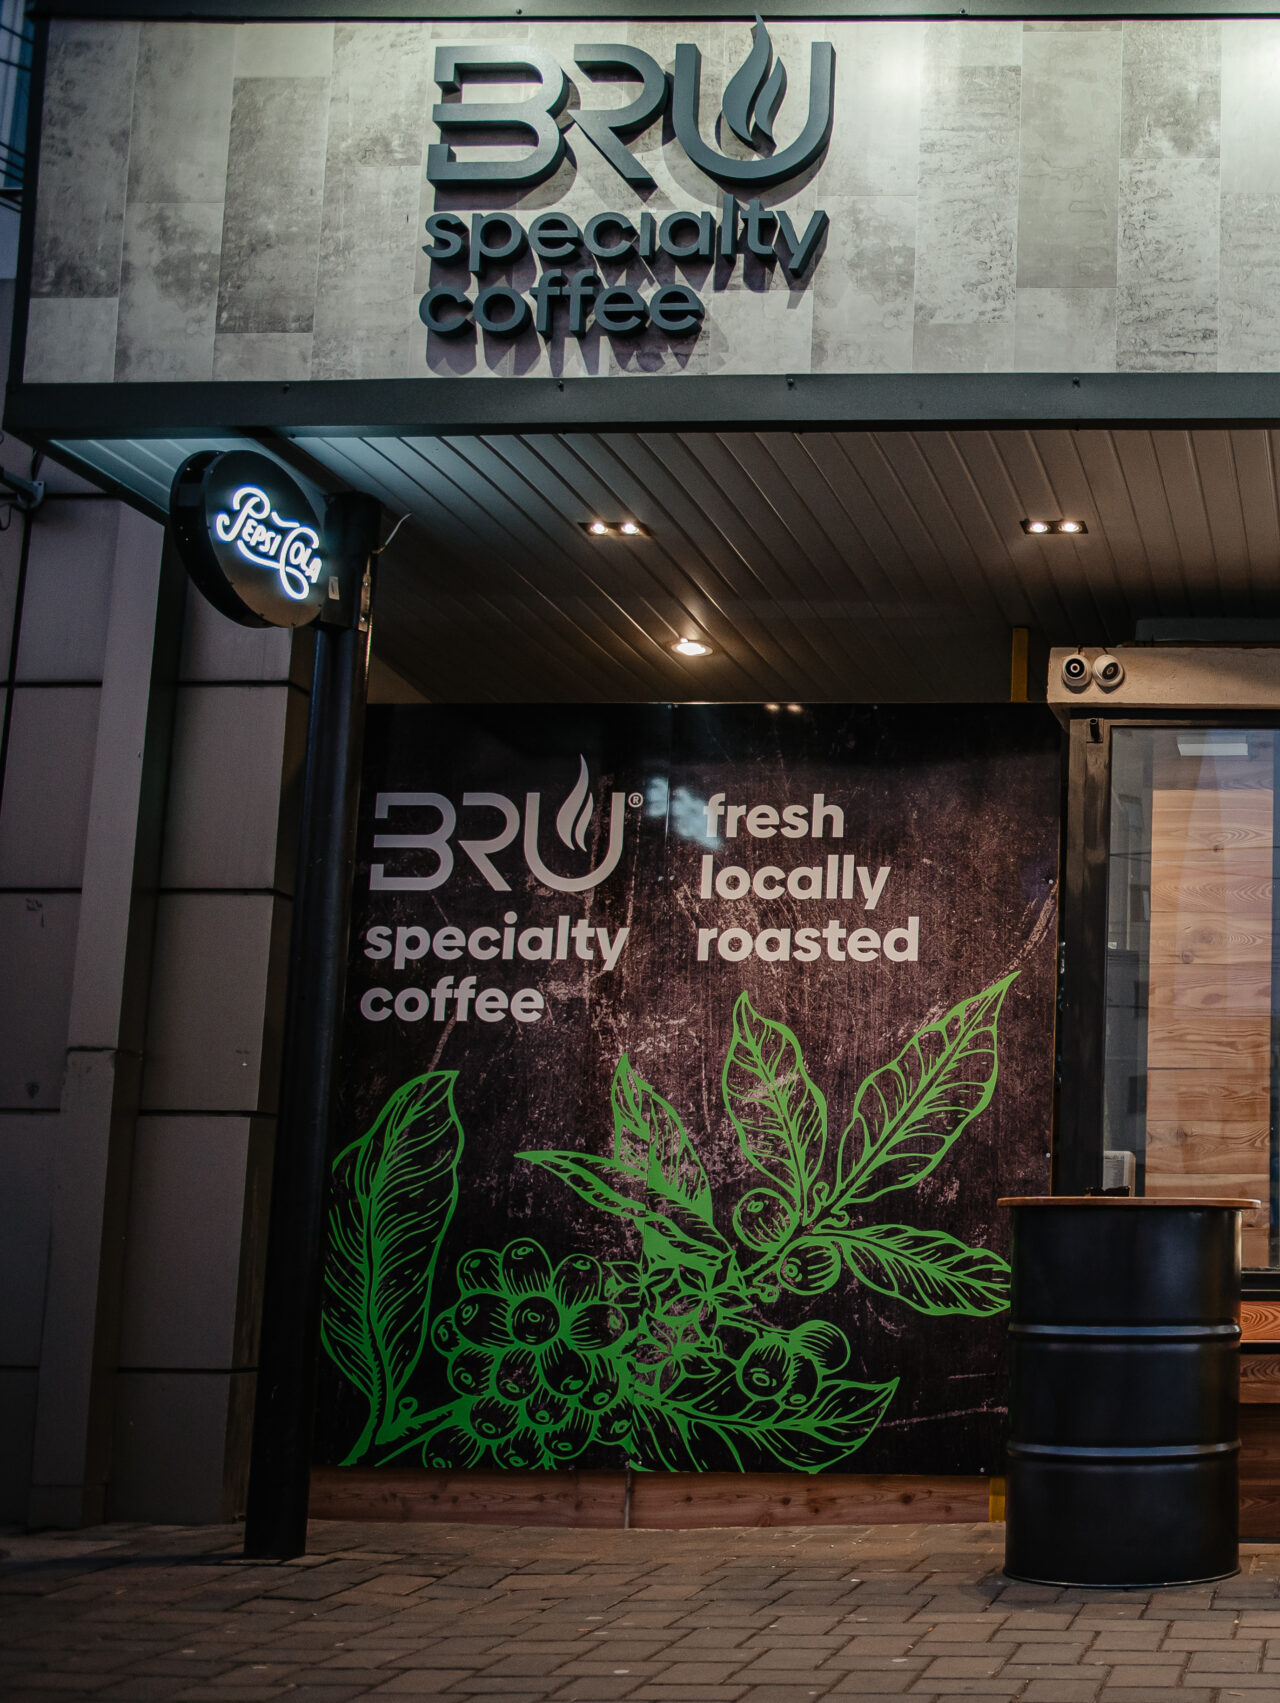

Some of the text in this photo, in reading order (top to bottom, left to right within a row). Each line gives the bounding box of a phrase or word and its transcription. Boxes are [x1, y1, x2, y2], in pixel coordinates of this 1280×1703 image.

[426, 38, 836, 188] BRU
[421, 193, 830, 278] specialty
[418, 268, 706, 336] coffee
[702, 792, 844, 839] fresh
[699, 853, 892, 910] locally
[363, 911, 631, 971] specialty
[696, 915, 920, 963] roasted
[359, 975, 546, 1023] coffee
